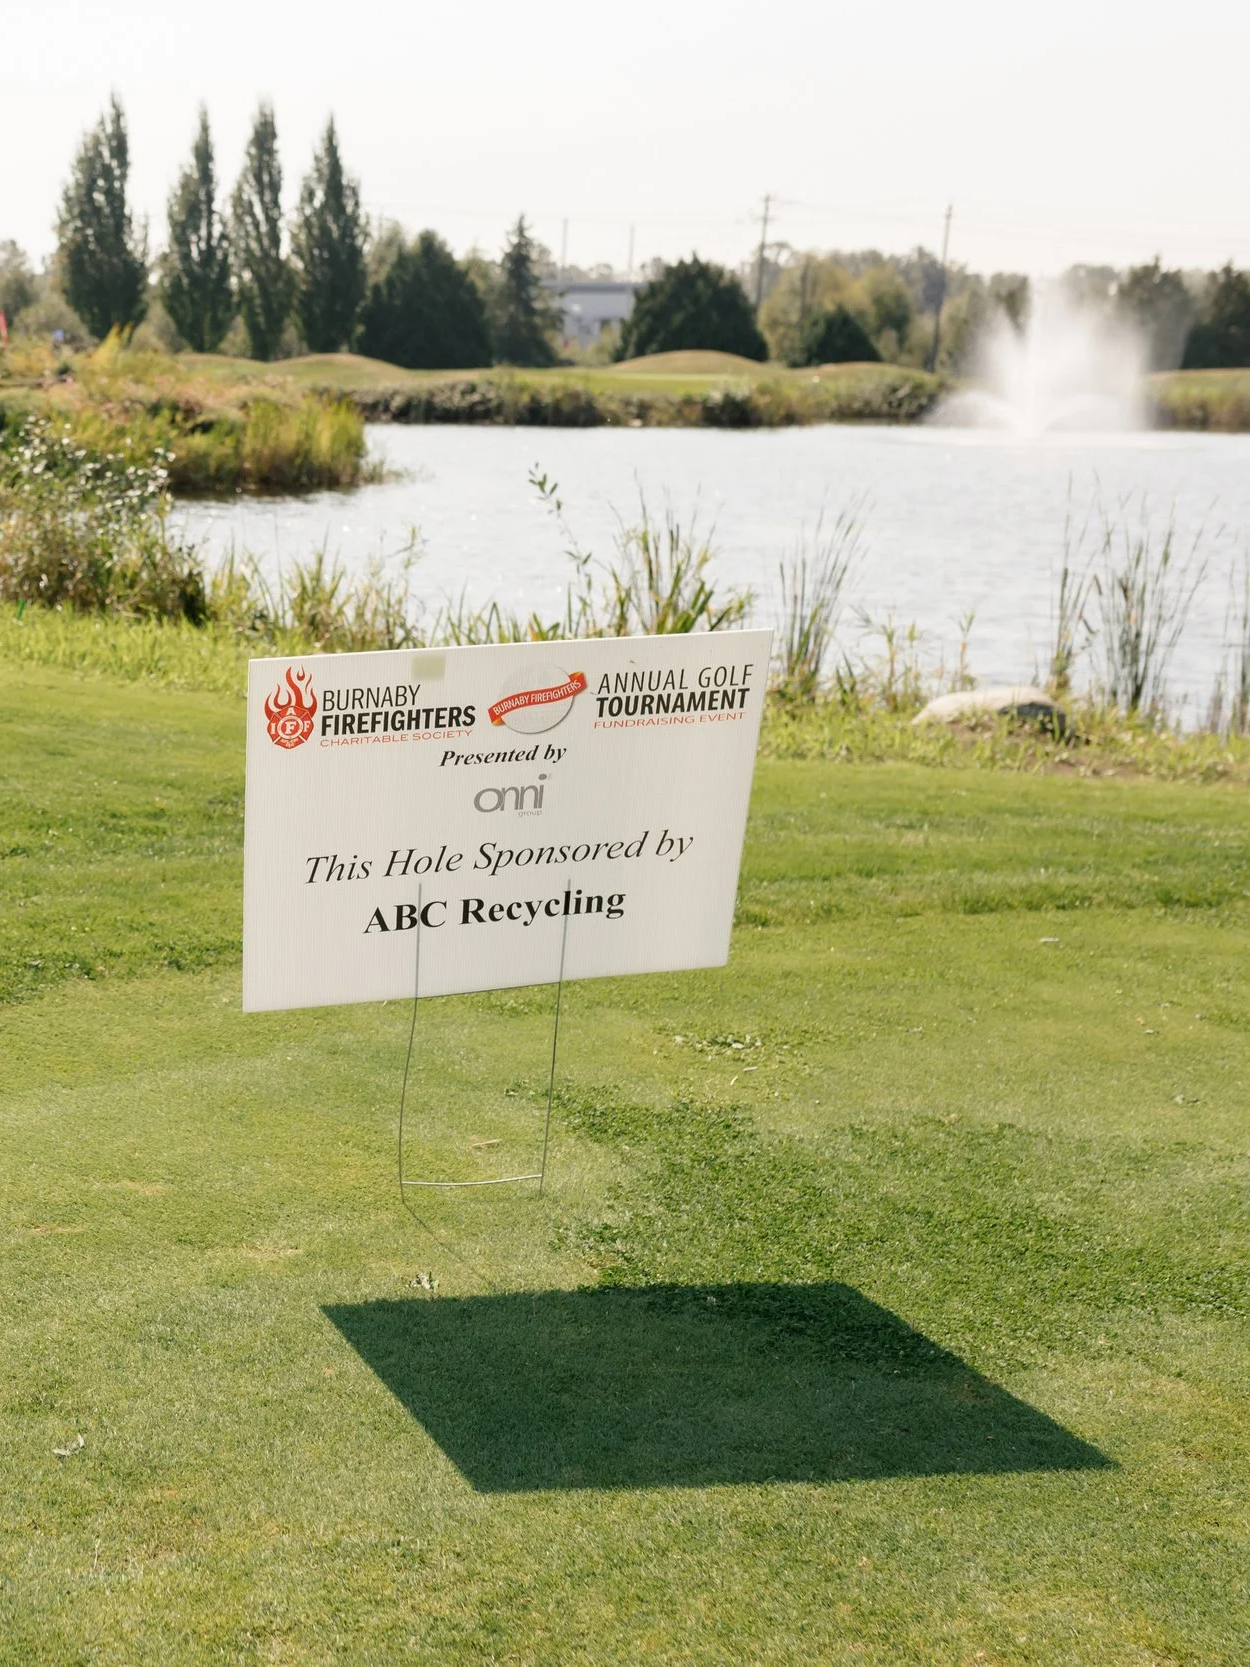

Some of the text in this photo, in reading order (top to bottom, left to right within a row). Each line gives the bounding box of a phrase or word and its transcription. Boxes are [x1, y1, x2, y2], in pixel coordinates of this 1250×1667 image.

[597, 664, 754, 695] ANNUAL GOLF
[322, 684, 421, 712] BURNABY
[493, 680, 582, 715] BURNABY FIREFIGHTERS
[596, 688, 750, 718] TOURNAMENT
[321, 705, 476, 737] FIREFIGHTERS
[593, 711, 746, 729] FUNDRAISING EVENT
[320, 729, 473, 748] CHARITABLE SOCIETY
[440, 744, 567, 767] Presented by
[473, 773, 548, 813] onni
[518, 810, 542, 818] group
[304, 829, 694, 884] This Hole Sponsored by
[362, 889, 627, 935] ABC Recycling
